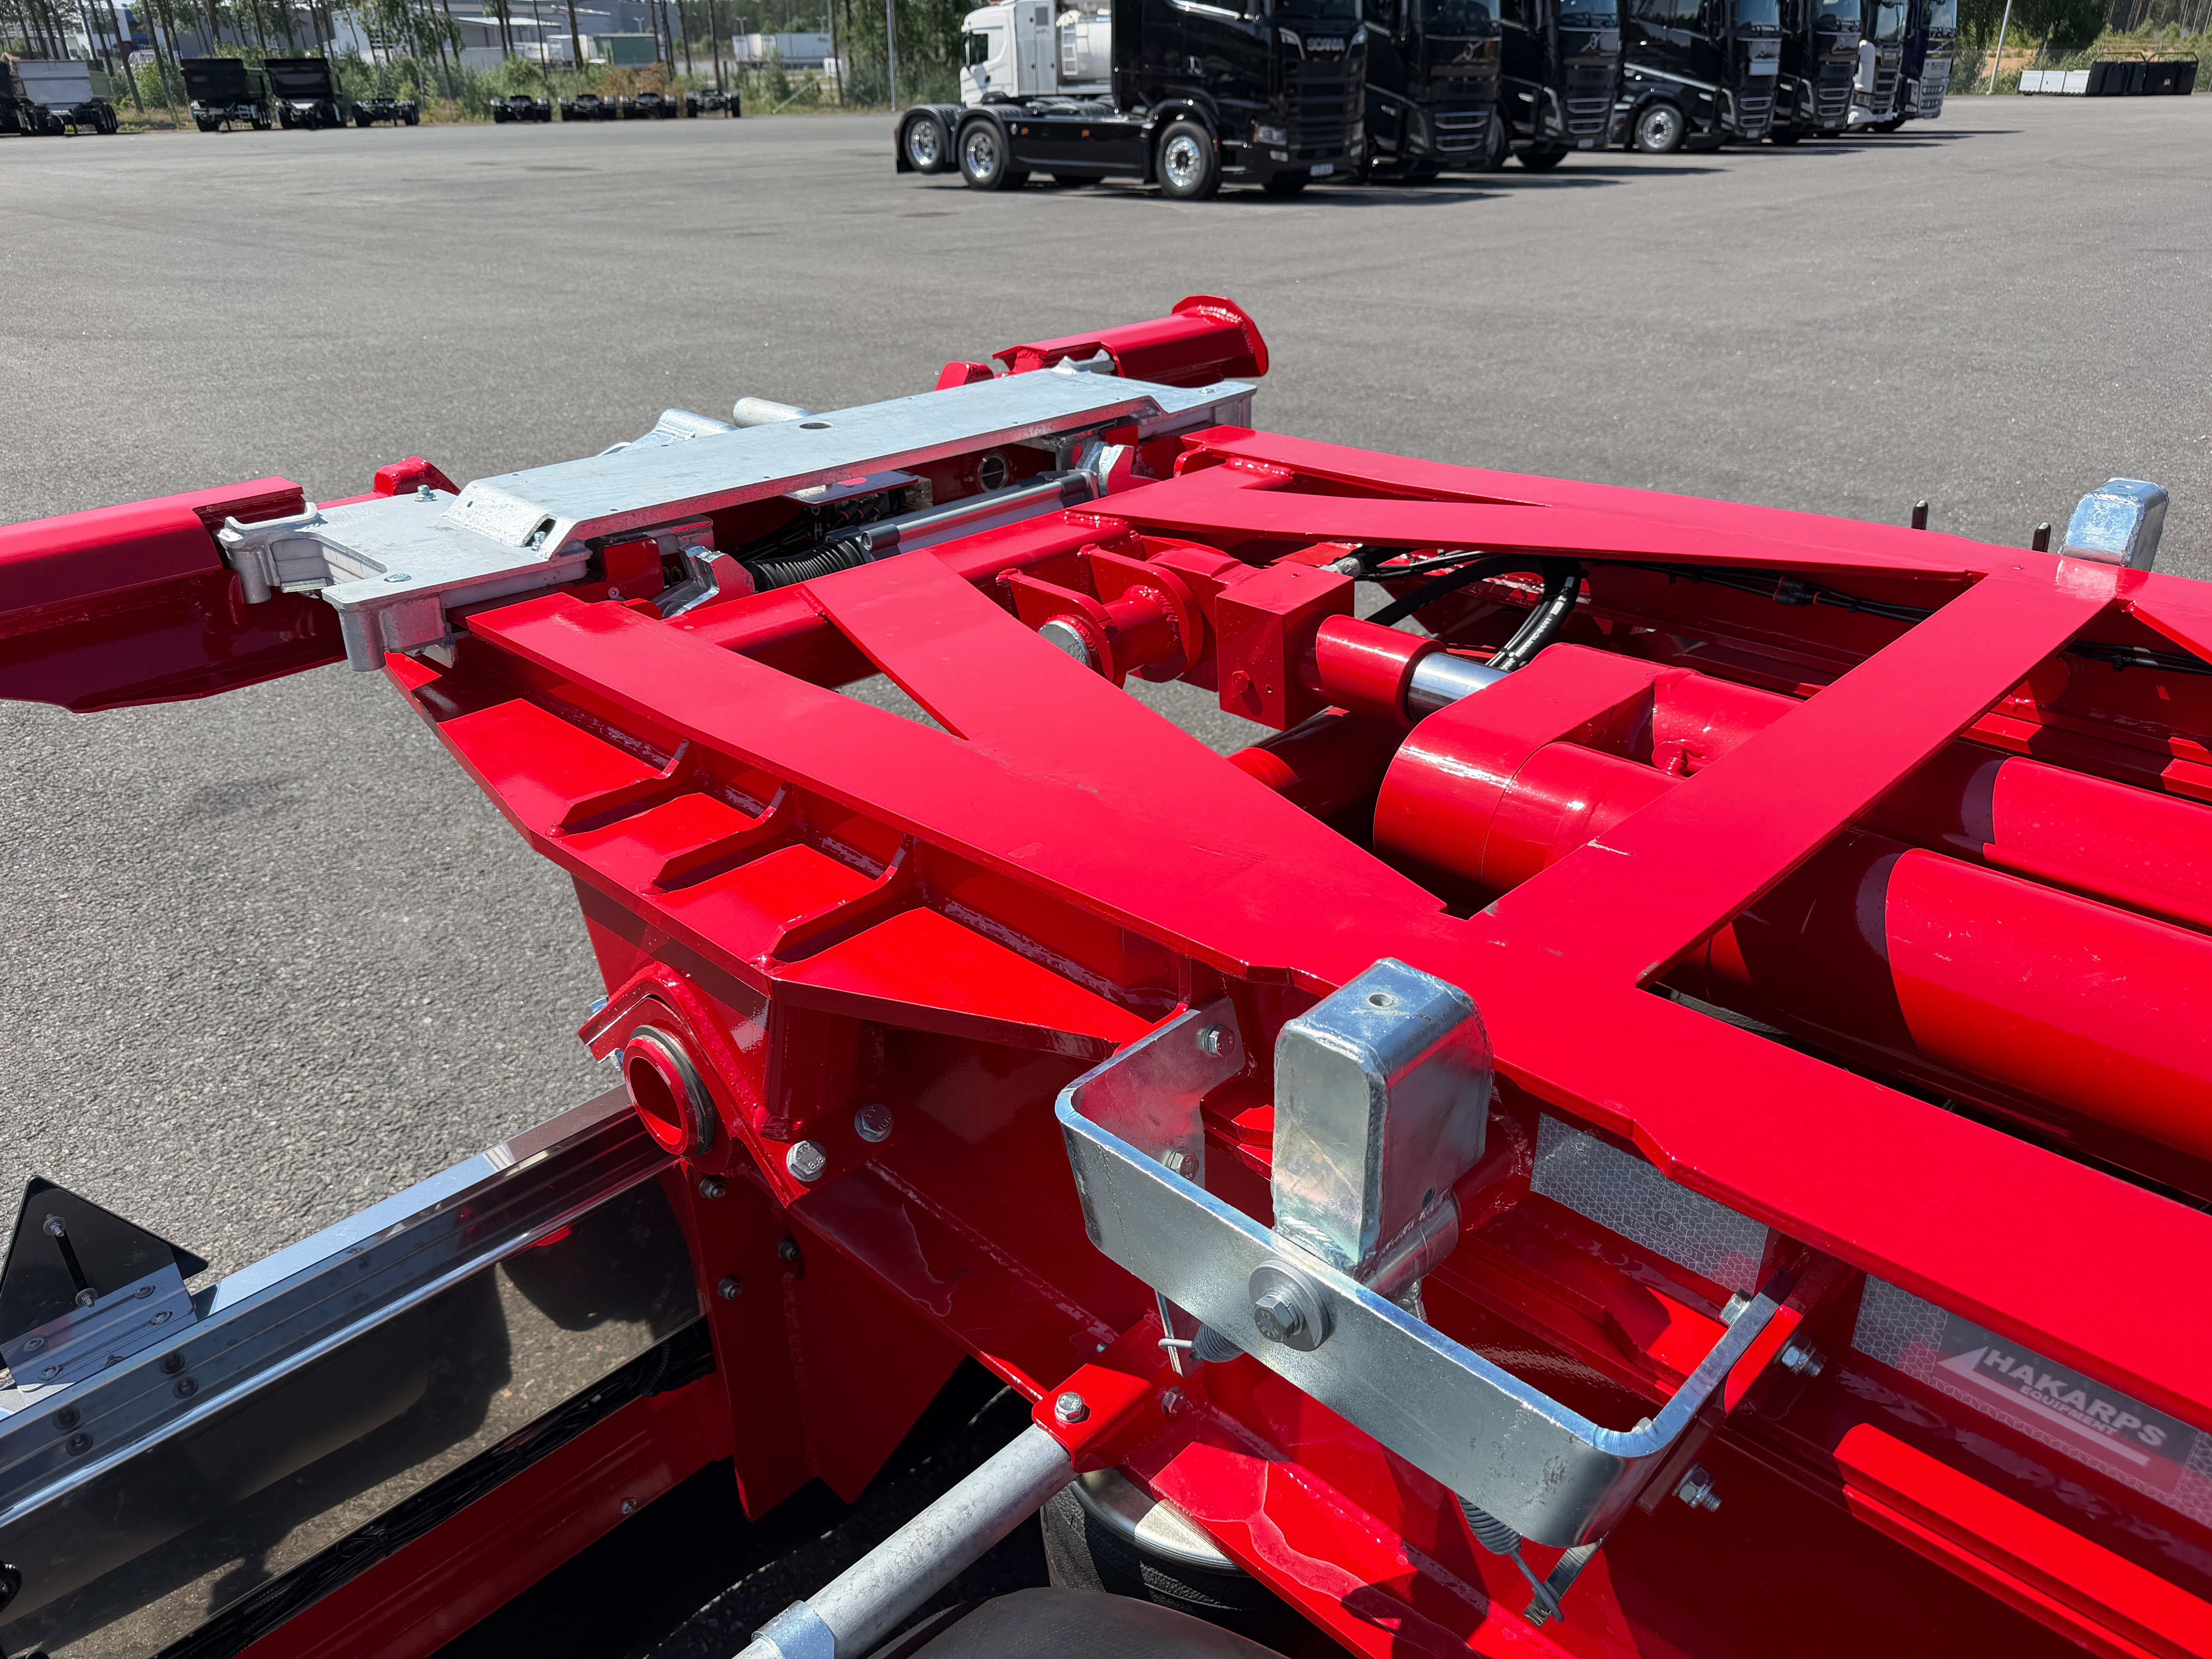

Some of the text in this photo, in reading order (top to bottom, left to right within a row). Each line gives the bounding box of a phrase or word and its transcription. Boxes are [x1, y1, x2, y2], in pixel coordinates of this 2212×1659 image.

[808, 1156, 824, 1170] 8.8
[1641, 1177, 1690, 1208] ORAFOL
[1629, 1219, 1647, 1233] 104
[1983, 1348, 2167, 1448] HAKARPS
[2019, 1384, 2118, 1436] EQUIPMENT
